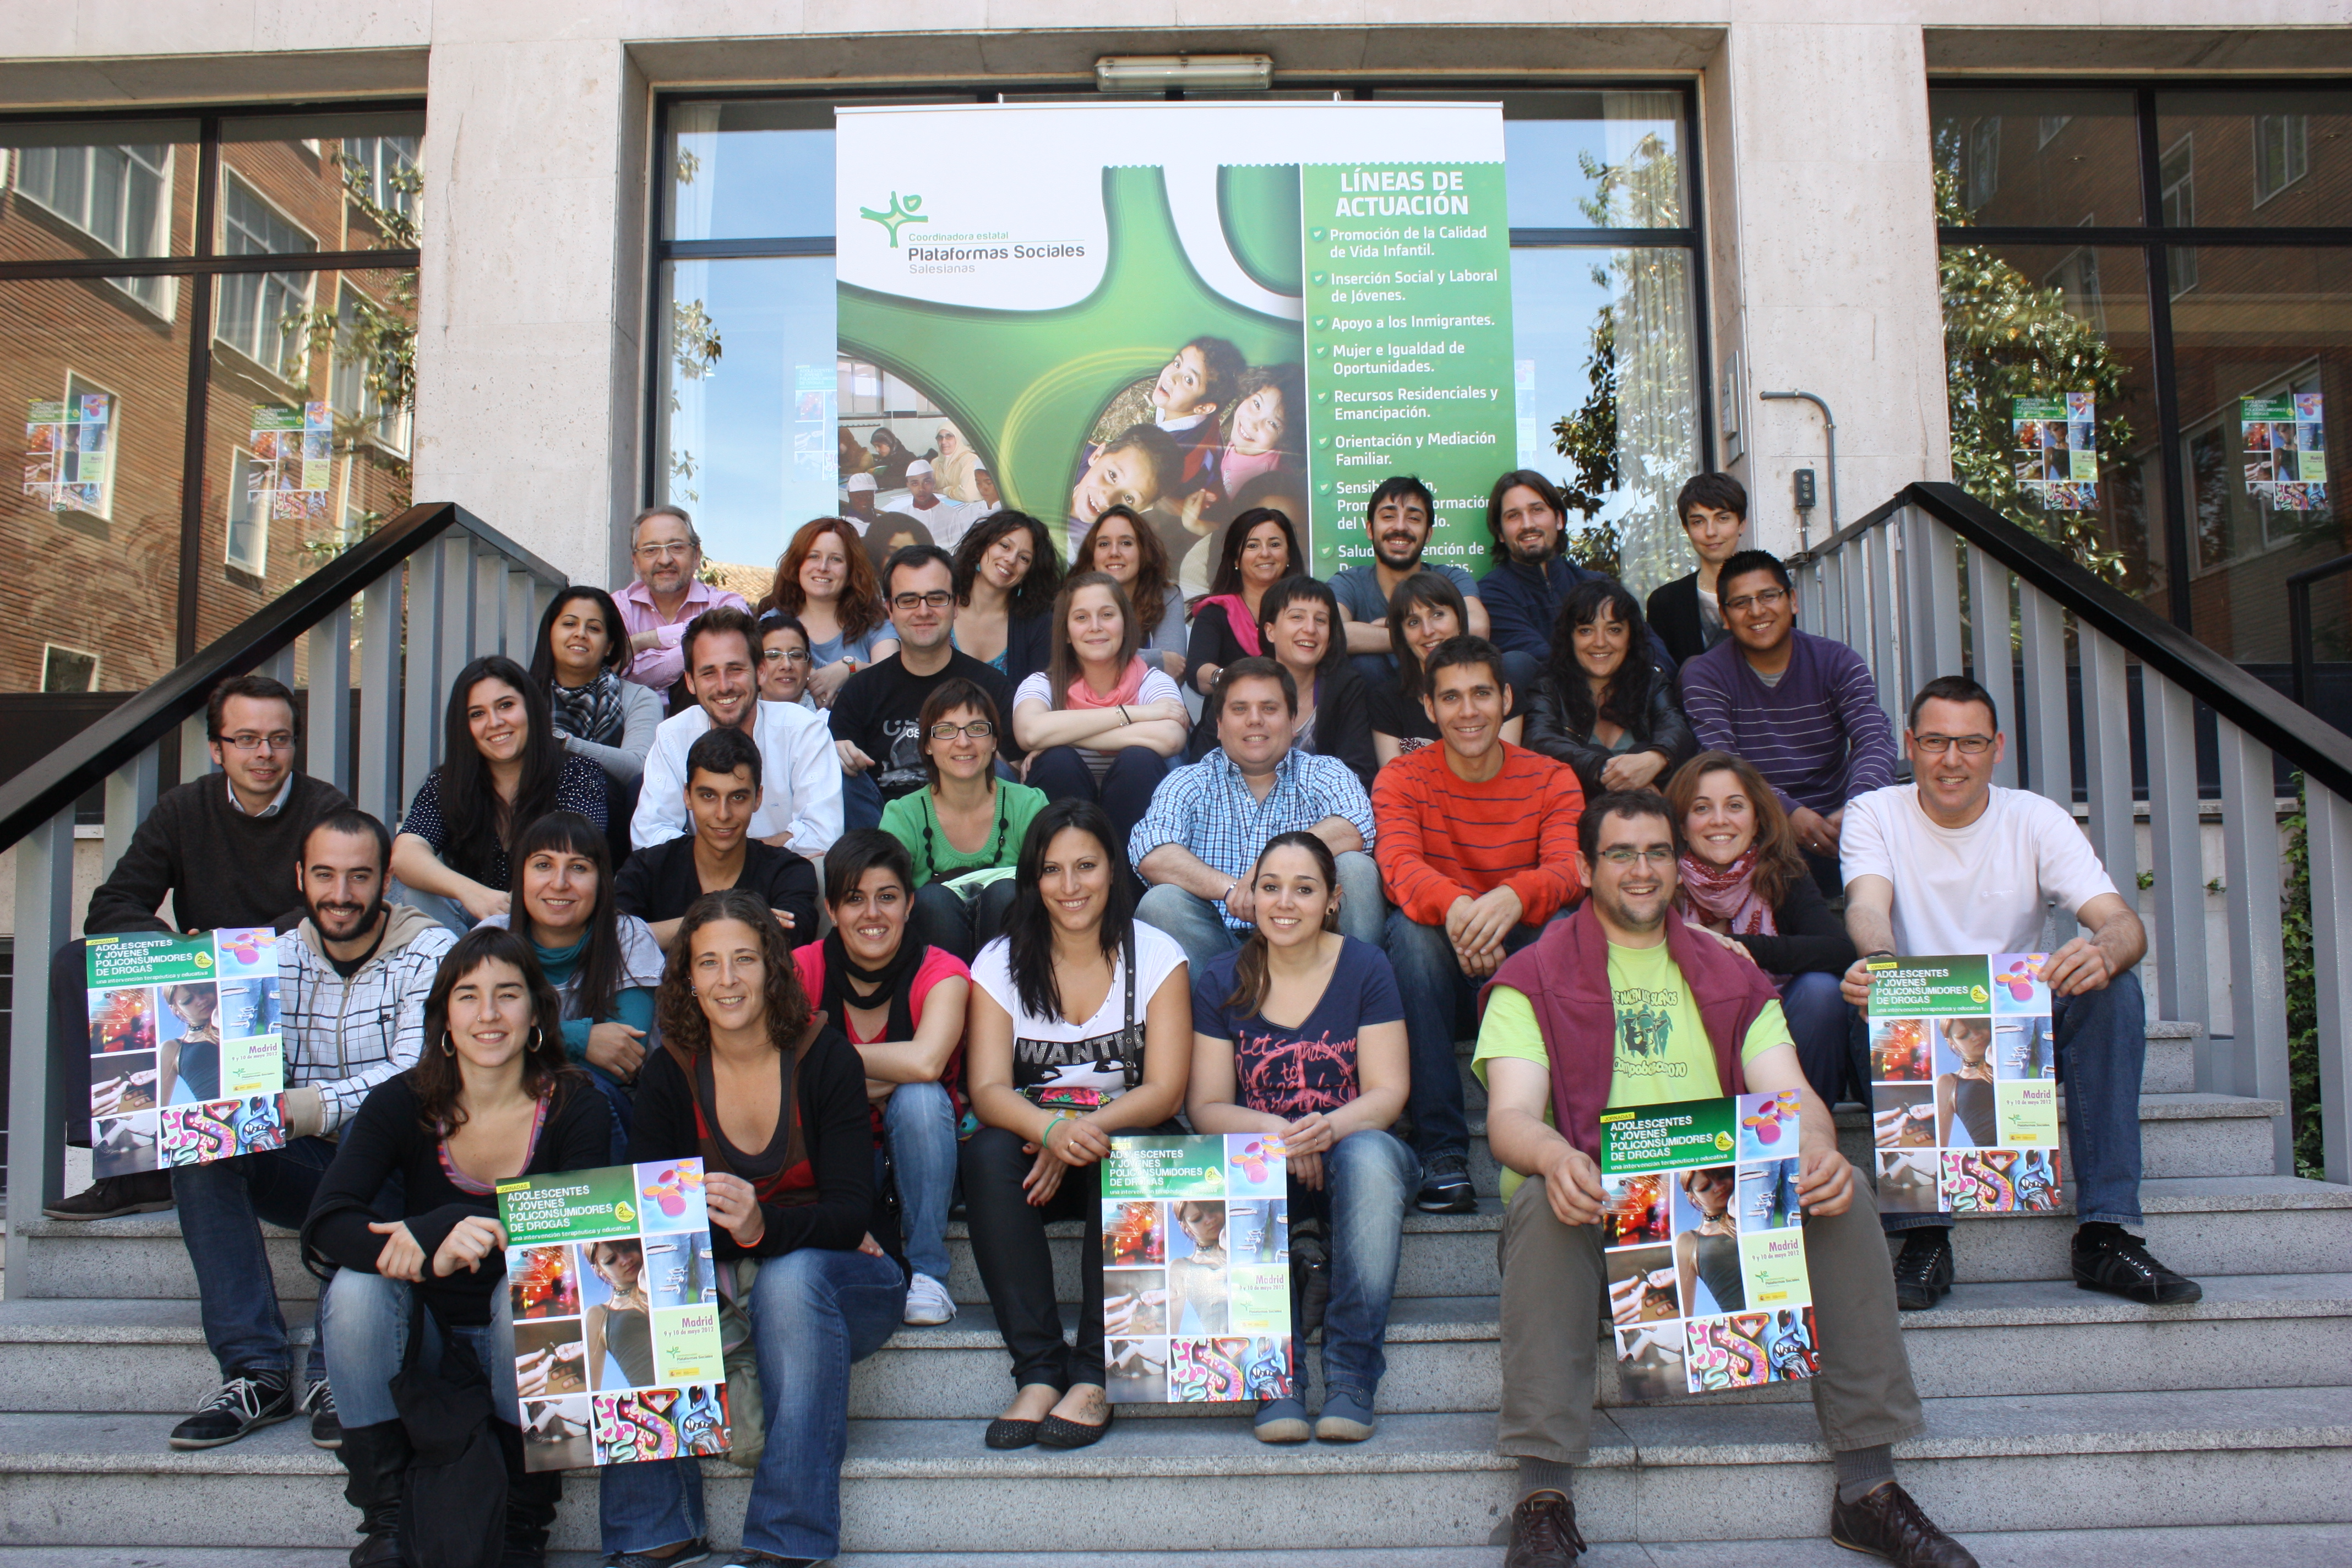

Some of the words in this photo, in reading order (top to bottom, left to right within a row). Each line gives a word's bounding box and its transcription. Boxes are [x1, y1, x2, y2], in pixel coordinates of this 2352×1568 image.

[1341, 168, 1424, 192] LÍNEAS
[1433, 171, 1463, 191] DE
[1335, 191, 1468, 217] ACTUACIÓN
[909, 232, 974, 242] Coordinadora
[976, 231, 1009, 240] estatal
[1330, 228, 1400, 241] Promoción
[1403, 227, 1419, 239] de
[1424, 226, 1435, 239] la
[1439, 226, 1487, 238] Calidad
[908, 247, 1008, 262] Plataformas
[1014, 244, 1085, 258] Sociales
[1330, 246, 1346, 258] de
[1349, 245, 1379, 257] Vida
[1384, 243, 1435, 257] Infantil.
[909, 264, 975, 274] Salesianas
[1331, 272, 1390, 285] Inserción
[1395, 270, 1433, 283] Social
[1438, 273, 1445, 285] y
[1450, 269, 1497, 282] Laboral
[1331, 290, 1347, 302] de
[1351, 290, 1406, 304] Jóvenes.
[1332, 317, 1372, 331] Apoyo
[1376, 318, 1384, 328] a
[1389, 315, 1407, 328] los
[1411, 314, 1495, 330] Inmigrantes.
[1333, 344, 1371, 359] Mujer
[1376, 345, 1384, 355] e
[1388, 341, 1444, 357] Igualdad
[1449, 341, 1464, 353] de
[1333, 360, 1434, 377] Oportunidades.
[1334, 390, 1393, 402] Recursos
[1398, 386, 1487, 401] Residenciales
[1490, 389, 1498, 401] y
[1335, 405, 1431, 421] Emancipación.
[1335, 434, 1411, 448] Orientación
[1415, 436, 1424, 449] y
[1428, 432, 1495, 445] Mediación
[1336, 452, 1392, 466] Familiar.
[1337, 516, 1357, 530] del
[1338, 545, 1375, 558] Salud
[1468, 542, 1484, 555] de
[95, 939, 173, 952] ADOLESCENTES
[96, 968, 109, 976] DE
[112, 965, 153, 975] DROGAS
[1876, 969, 1949, 978] ADOLESCENTES
[1892, 996, 1930, 1004] DROGAS
[249, 1043, 277, 1054] Madrid
[2023, 1089, 2051, 1098] Madrid
[1610, 1115, 1692, 1131] ADOLESCENTES
[1610, 1133, 1617, 1141] Y
[1611, 1152, 1625, 1161] DE
[1627, 1147, 1671, 1160] DROGAS
[500, 1183, 528, 1192] JORNADAS
[1110, 1178, 1122, 1186] DE
[508, 1185, 590, 1202] ADOLESCENTES
[508, 1203, 515, 1211] Y
[510, 1223, 524, 1232] DE
[526, 1218, 570, 1231] DROGAS
[523, 1232, 560, 1240] intervención
[1769, 1238, 1798, 1252] Madrid
[1256, 1274, 1283, 1284] Madrid
[682, 1315, 713, 1328] Madrid
